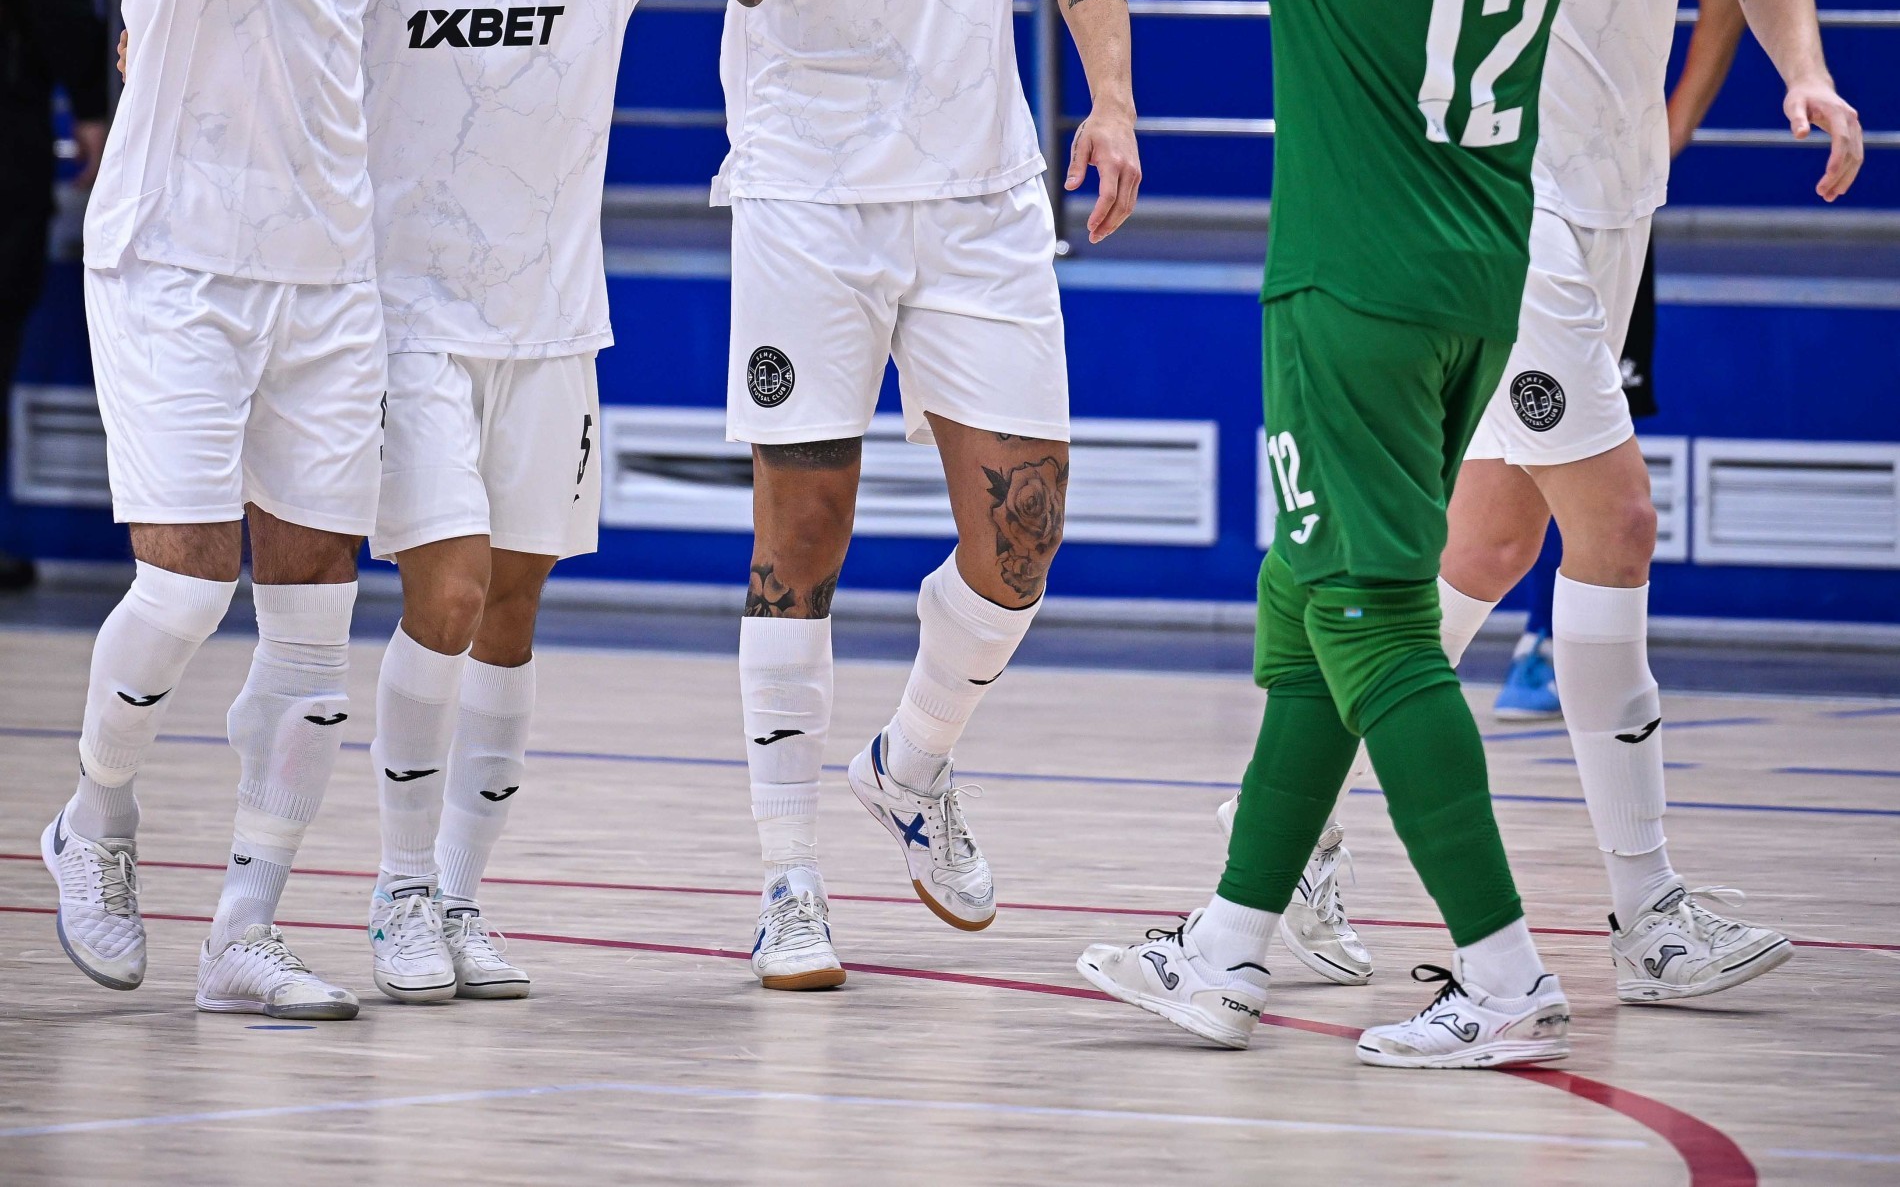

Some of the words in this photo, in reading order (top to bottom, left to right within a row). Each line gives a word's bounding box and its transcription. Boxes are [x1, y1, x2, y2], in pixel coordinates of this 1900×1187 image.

[407, 6, 566, 49] 1XBET
[576, 414, 592, 485] 5
[1267, 431, 1317, 513] 12
